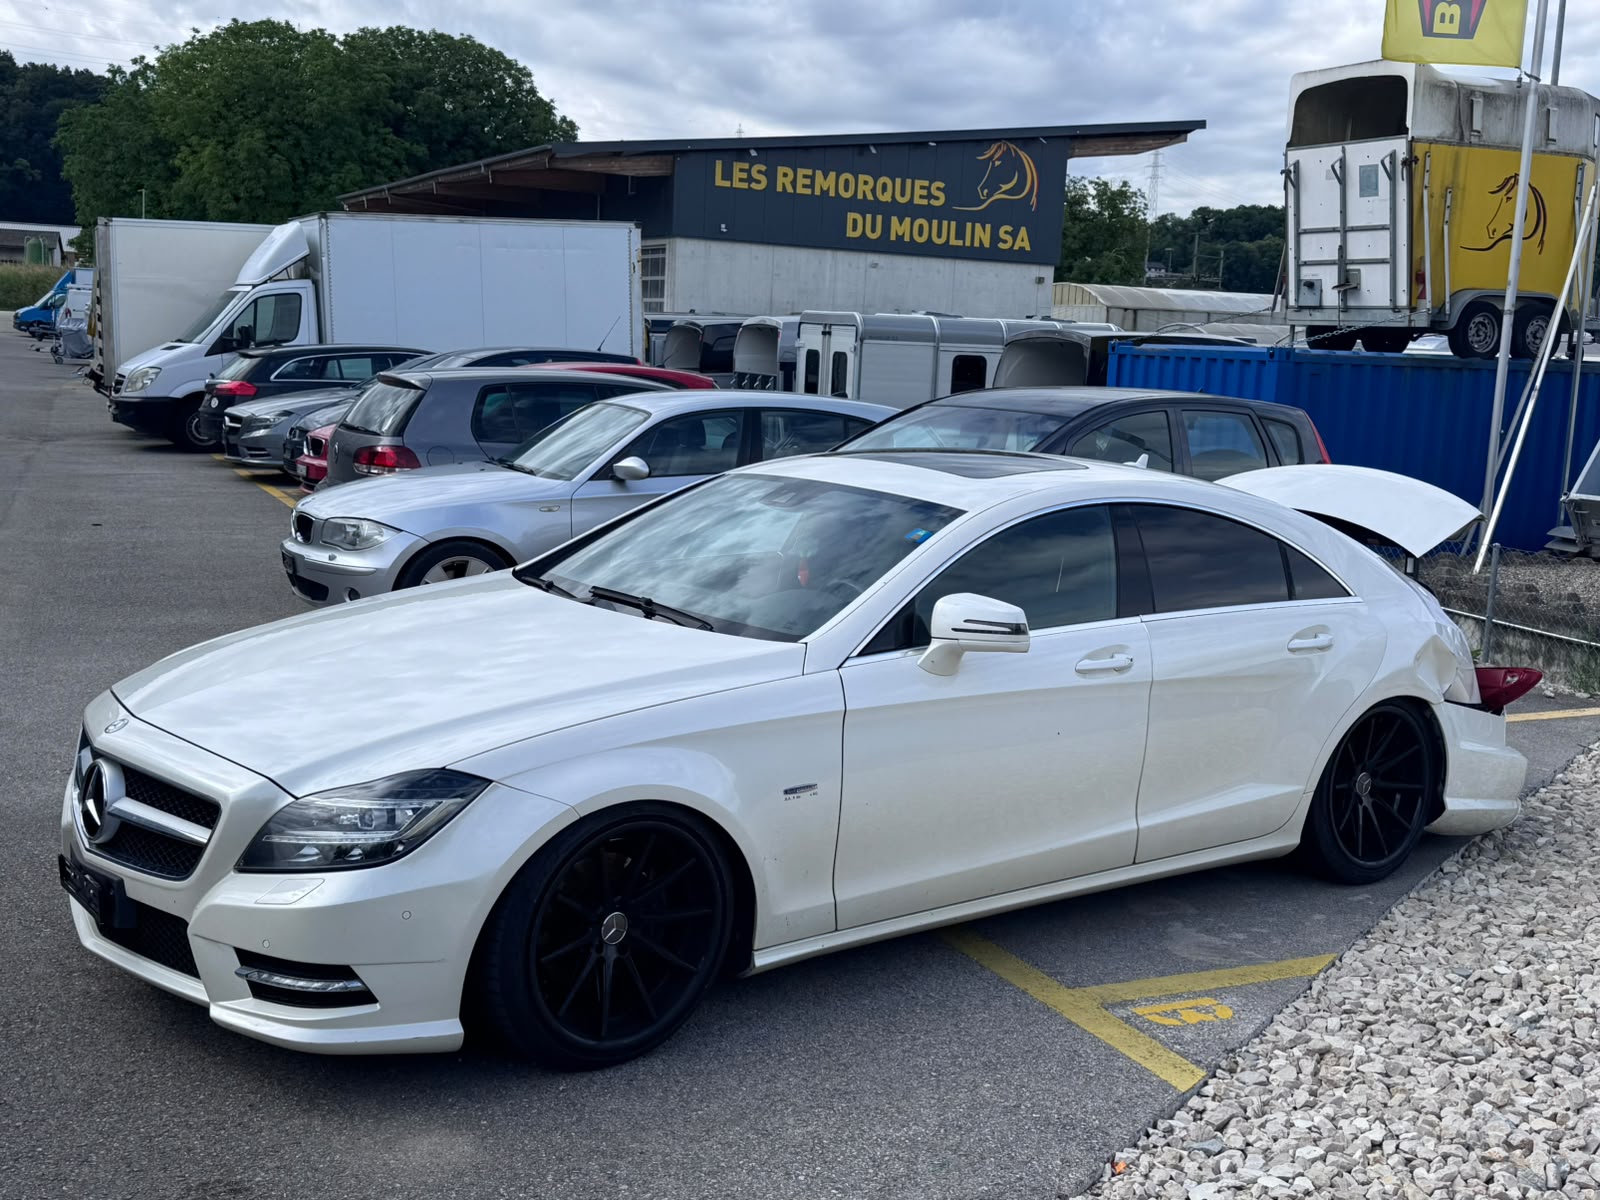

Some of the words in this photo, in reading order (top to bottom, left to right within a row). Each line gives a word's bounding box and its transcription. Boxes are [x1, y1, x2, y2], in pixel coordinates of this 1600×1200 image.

[1433, 0, 1460, 34] B
[715, 160, 767, 191] LES
[776, 166, 946, 207] REMORQUES
[846, 212, 883, 240] DU
[890, 216, 992, 248] MOULIN
[997, 225, 1031, 251] SA
